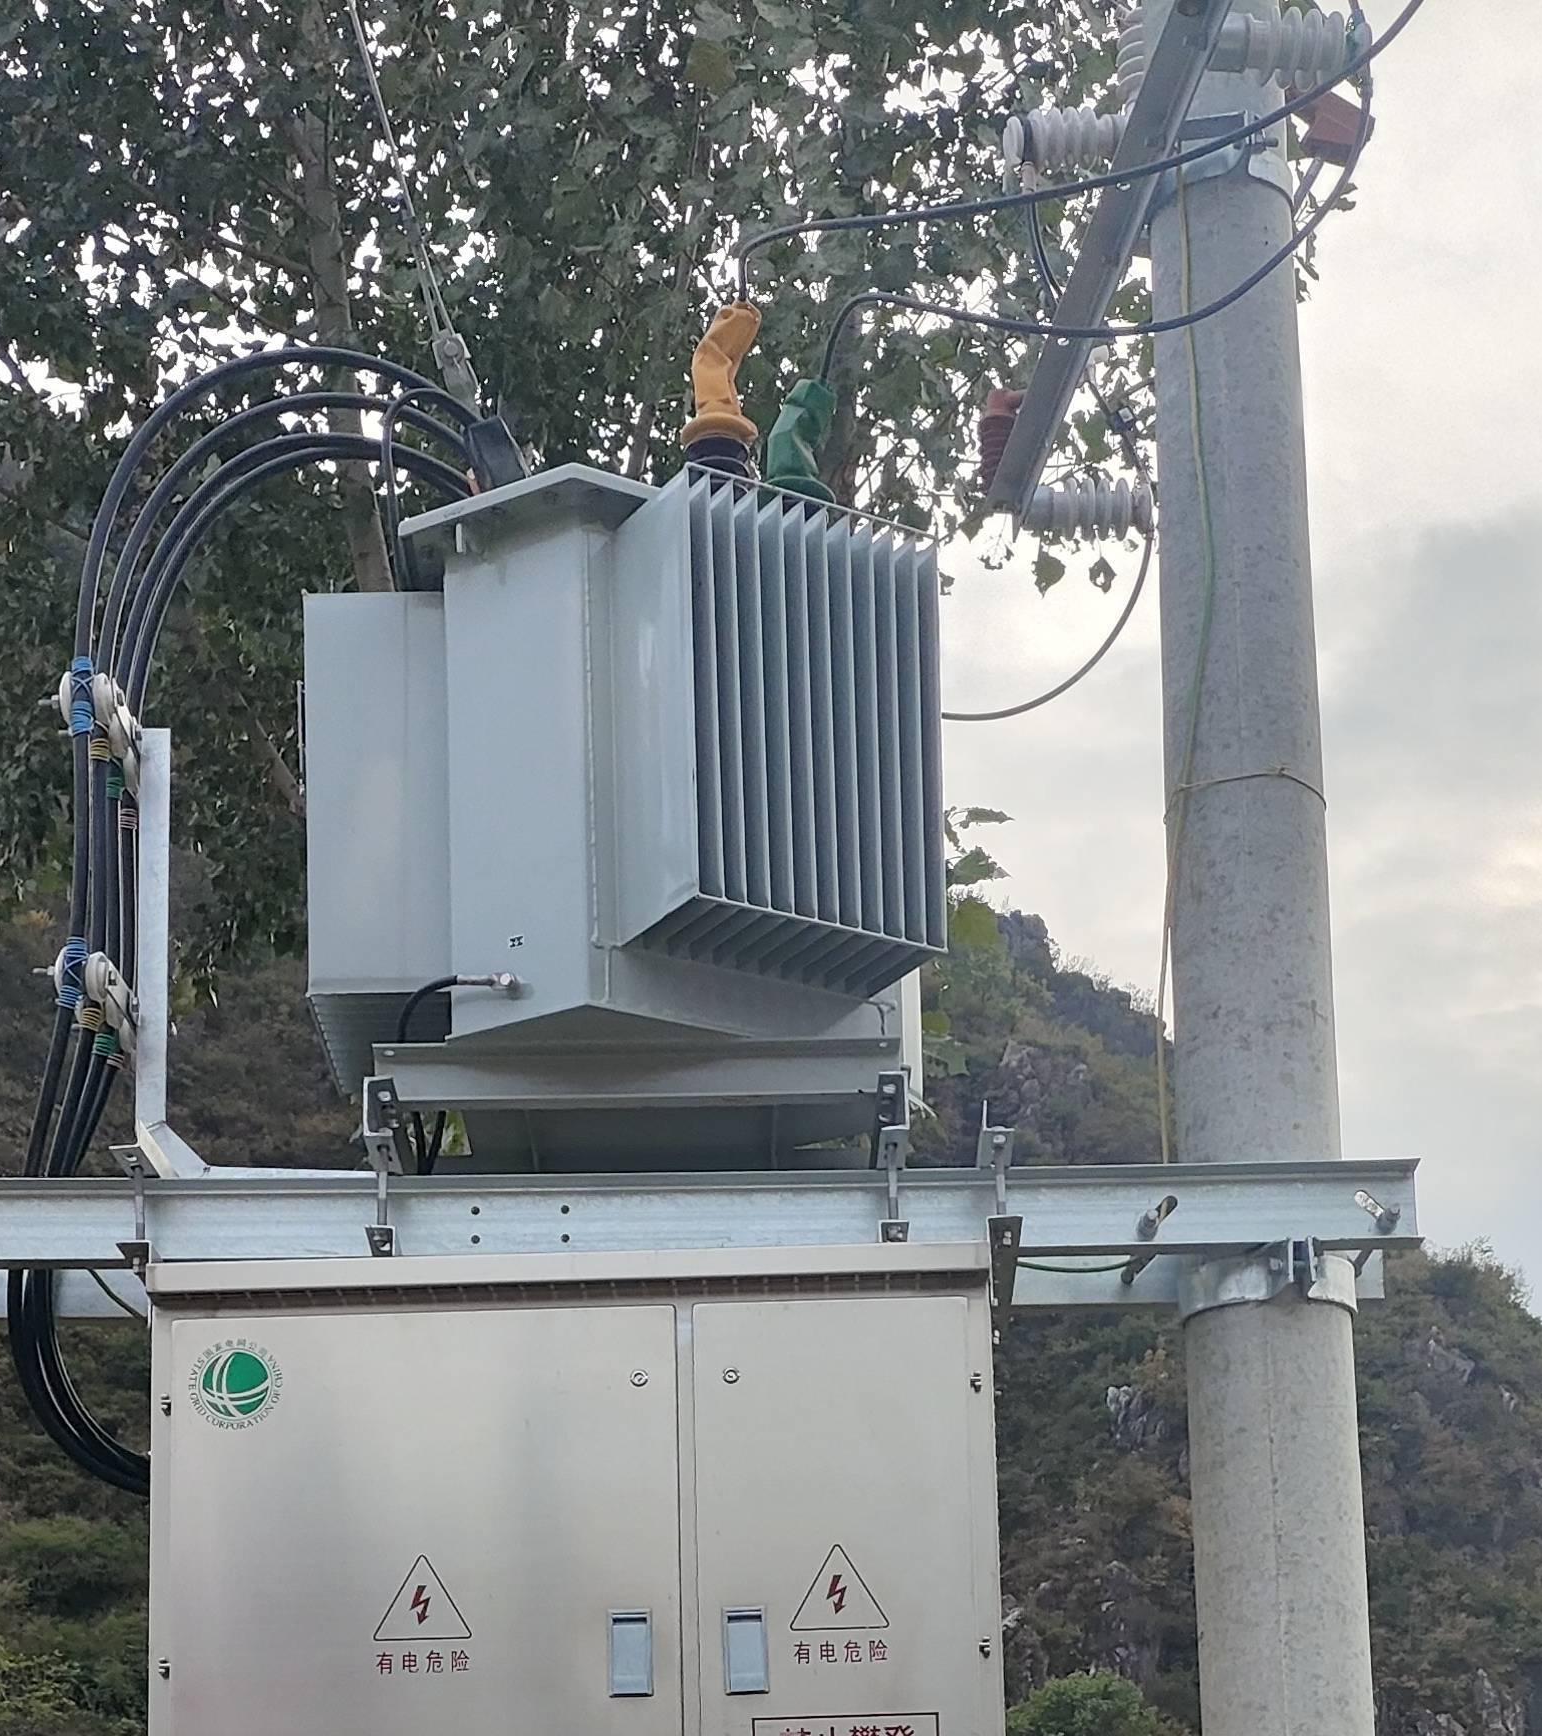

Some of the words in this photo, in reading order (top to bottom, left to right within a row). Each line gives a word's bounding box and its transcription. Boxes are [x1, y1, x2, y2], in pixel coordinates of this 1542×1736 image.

[188, 1357, 205, 1390] STATE
[267, 1355, 284, 1390] CHINA
[189, 1392, 207, 1417] GRID
[205, 1406, 275, 1430] CORPORATION
[375, 1649, 471, 1674] 有电危险
[793, 1639, 889, 1665] 有电危险
